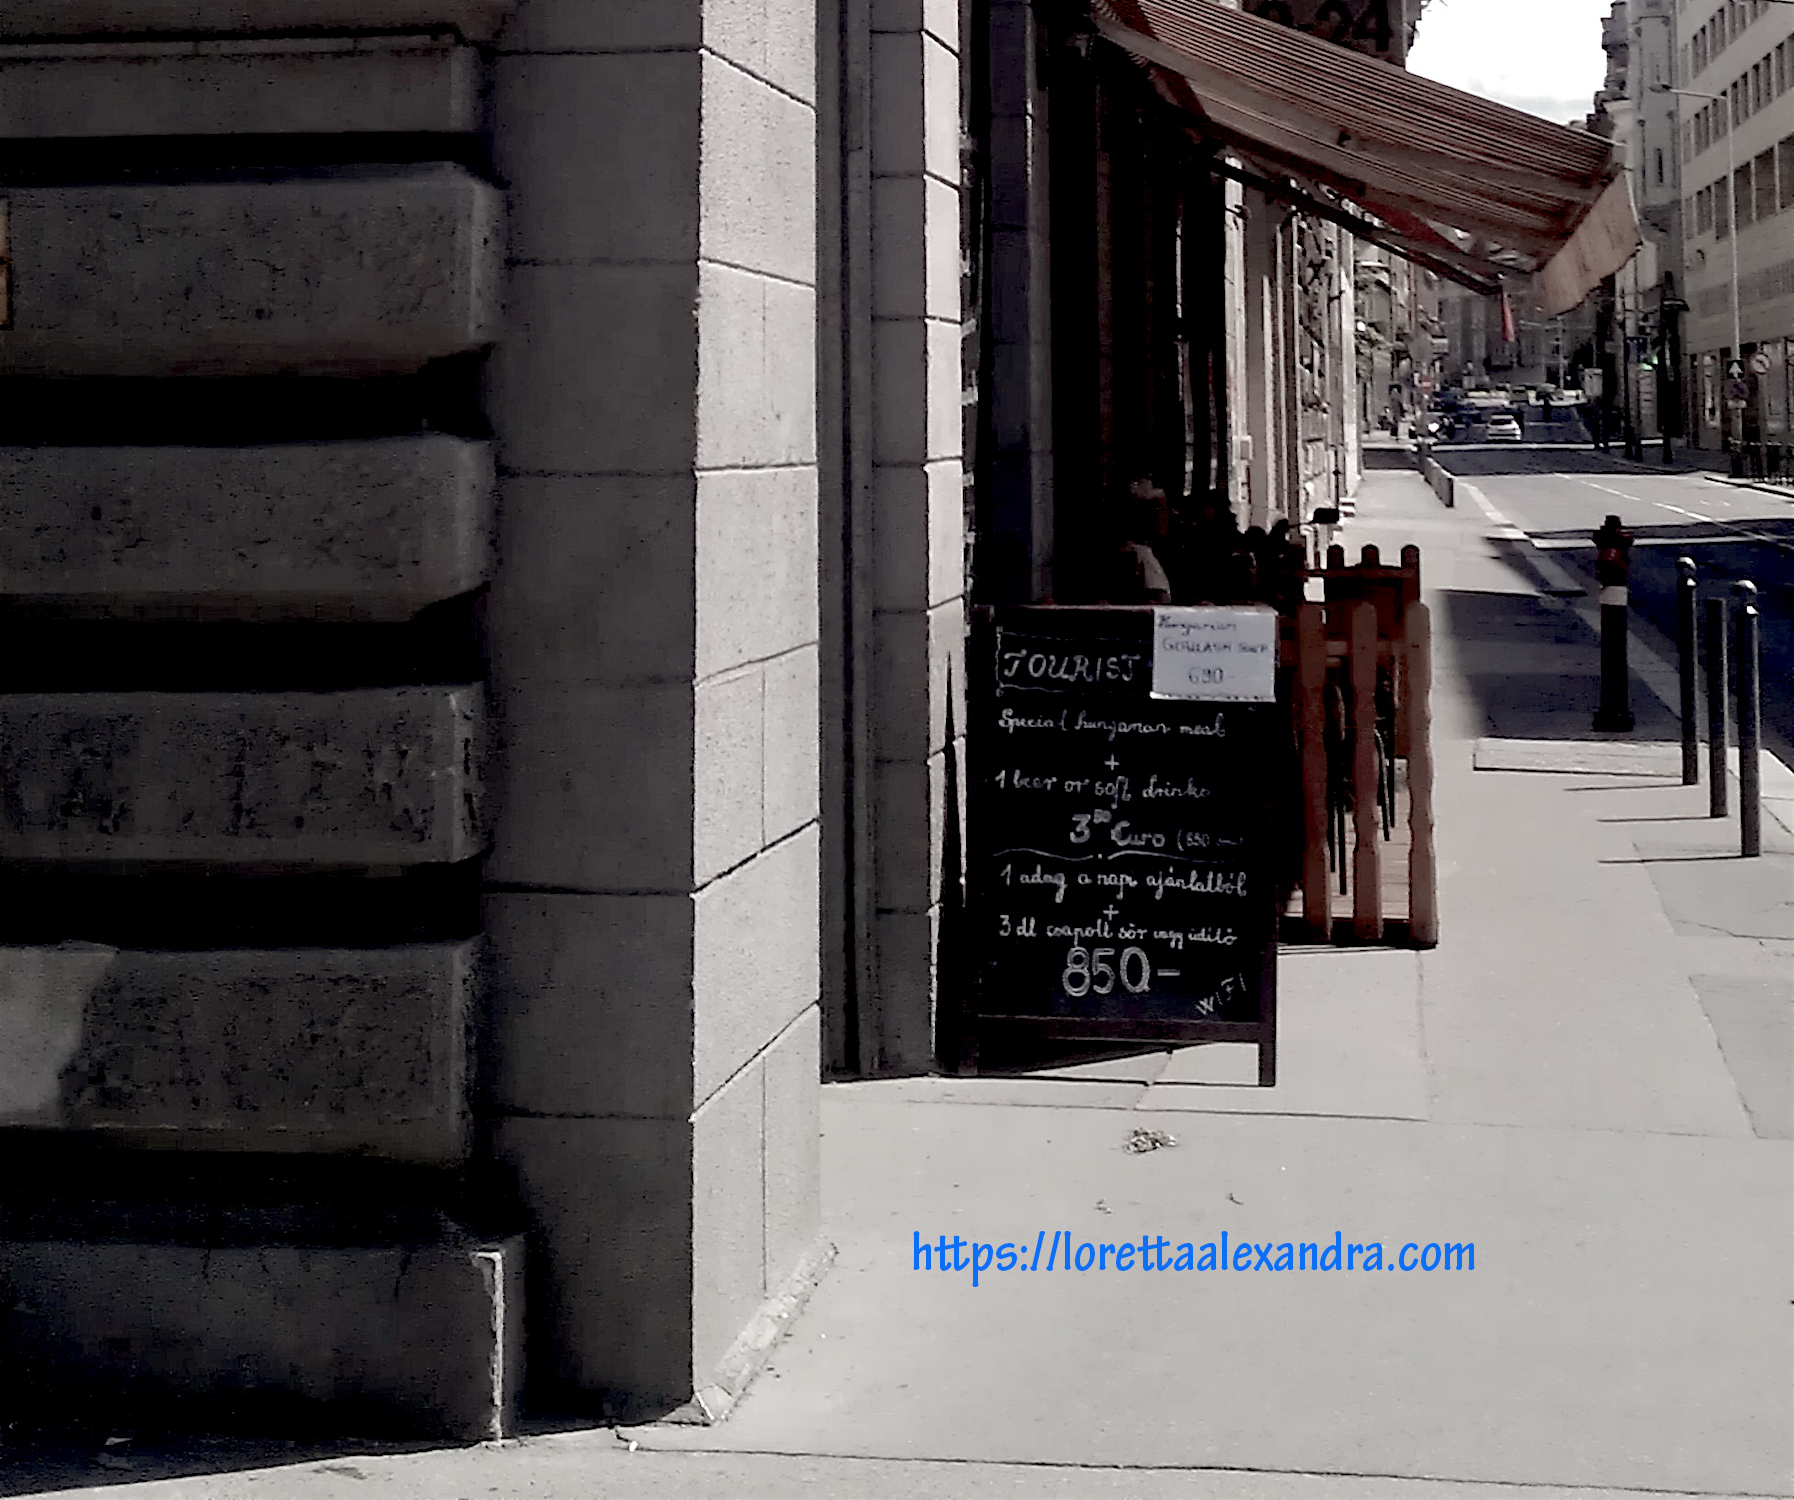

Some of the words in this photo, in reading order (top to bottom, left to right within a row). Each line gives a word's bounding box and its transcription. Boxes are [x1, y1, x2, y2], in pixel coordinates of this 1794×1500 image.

[1003, 648, 1142, 683] TOURIST
[1064, 778, 1091, 794] or
[1110, 820, 1166, 848] Euro
